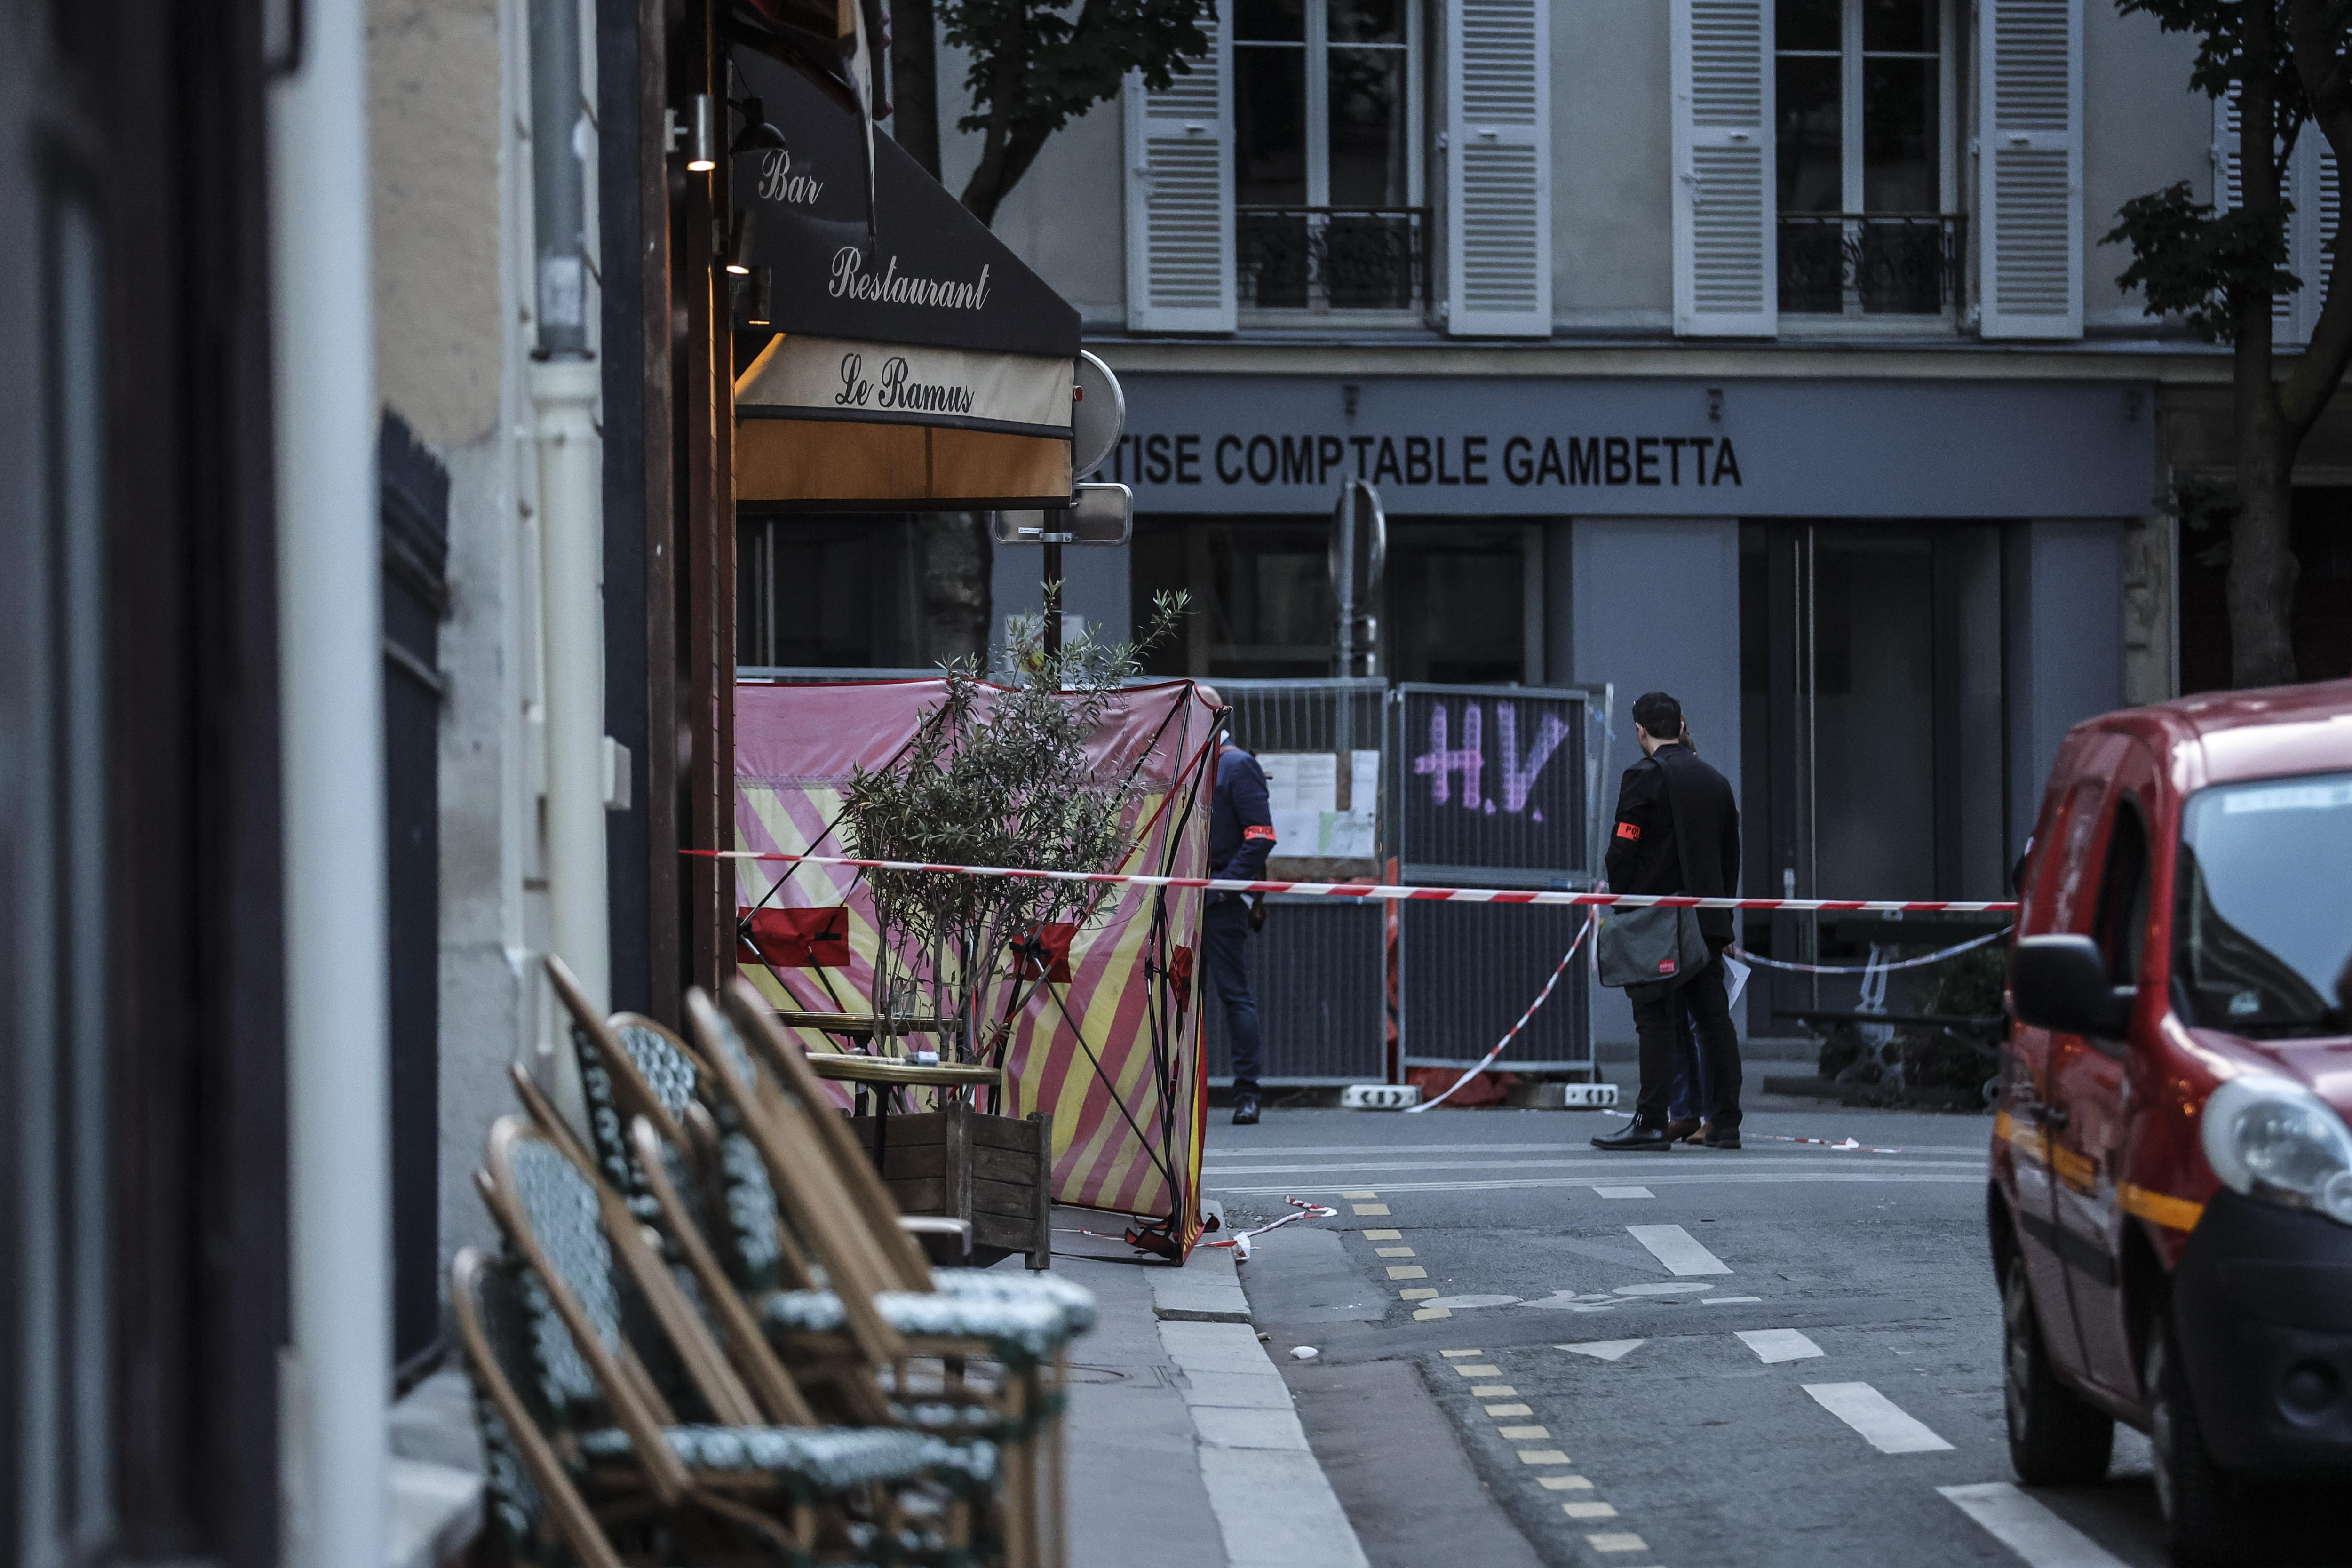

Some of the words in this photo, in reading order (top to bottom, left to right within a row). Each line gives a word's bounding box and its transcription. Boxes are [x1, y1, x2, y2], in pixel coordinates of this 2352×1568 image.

[758, 148, 824, 204] Bar
[829, 246, 990, 310] Restaurant
[835, 352, 874, 406] Le
[878, 356, 975, 413] Ramus
[1093, 433, 1202, 485] TISE
[1215, 434, 1488, 485] COMPTABLE
[1503, 436, 1742, 486] GAMBETTA
